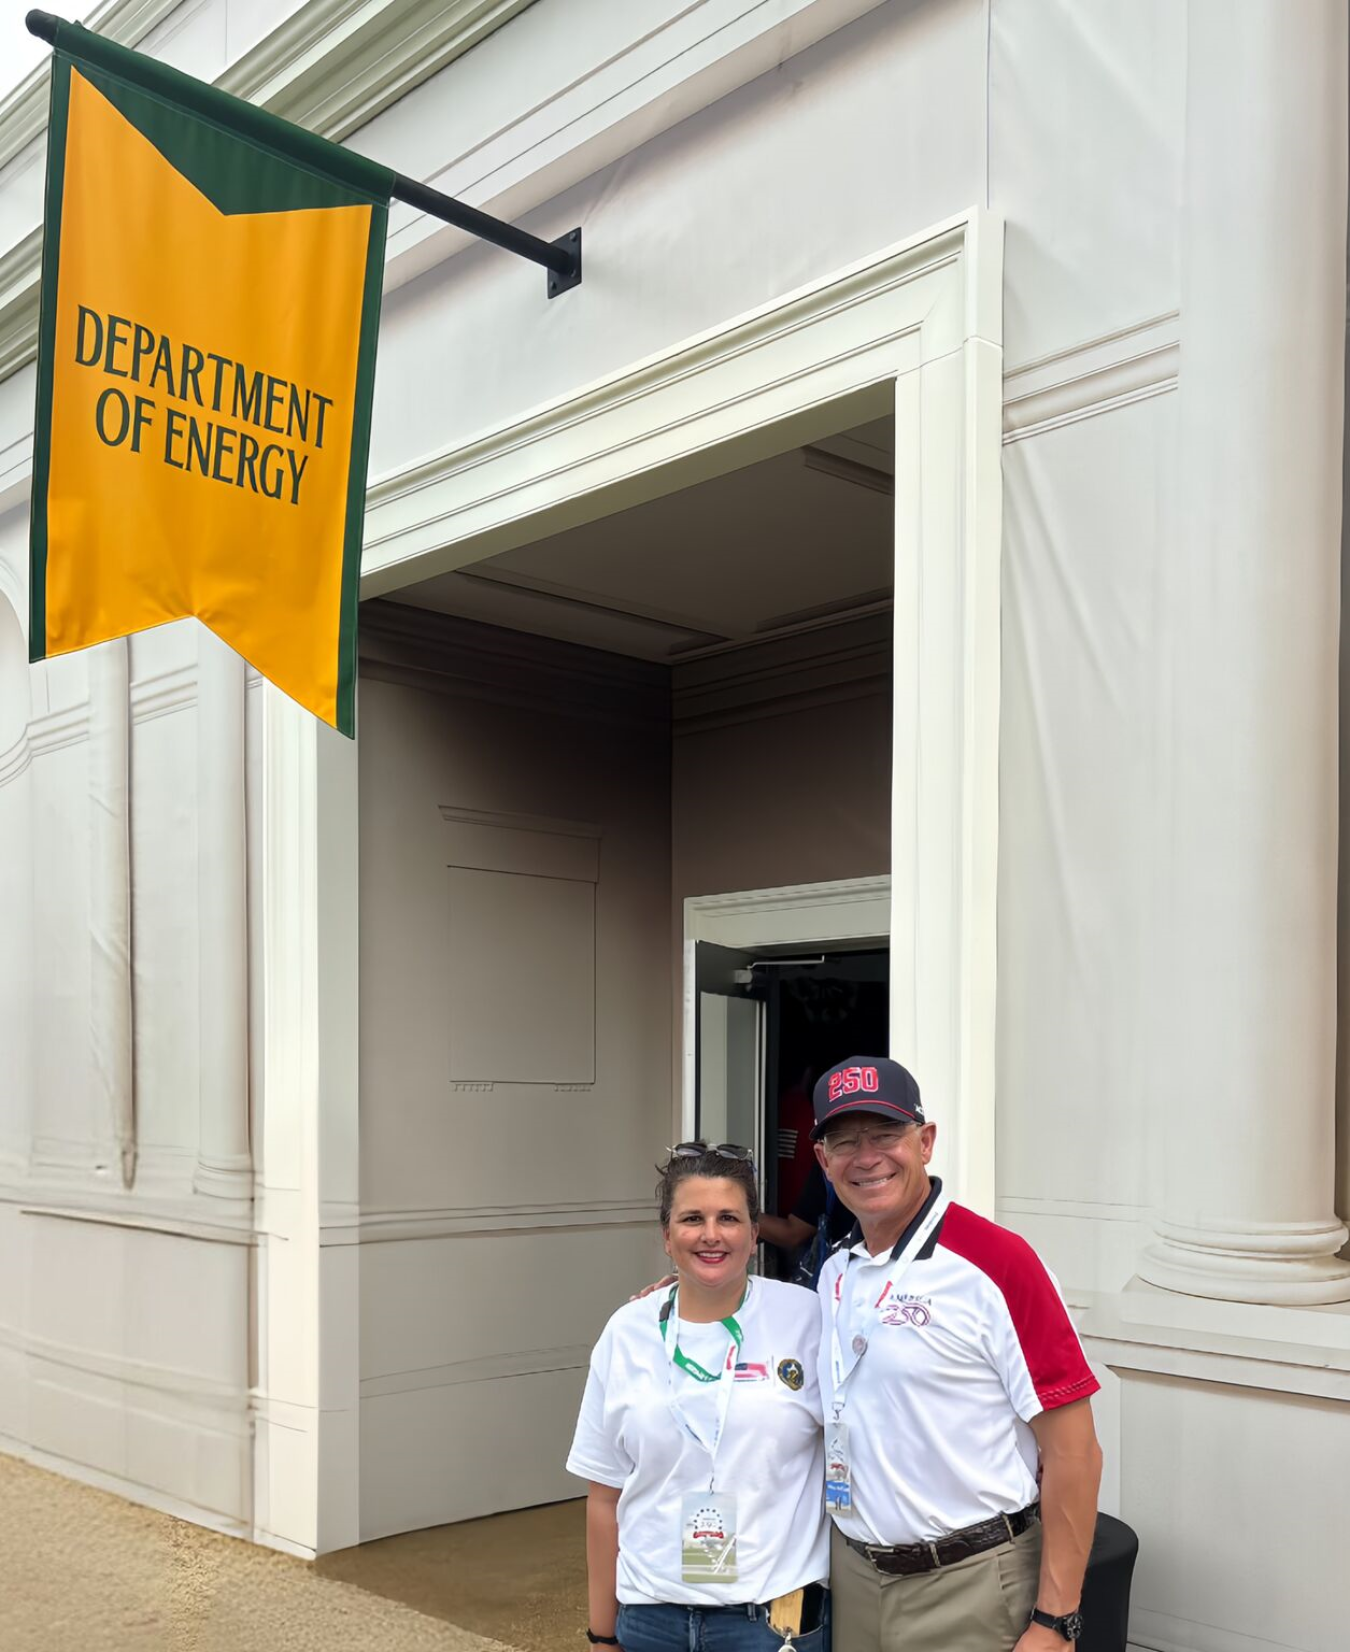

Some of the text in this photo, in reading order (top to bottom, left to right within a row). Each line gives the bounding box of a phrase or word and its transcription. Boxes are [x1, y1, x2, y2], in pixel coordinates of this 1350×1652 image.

[75, 304, 334, 449] DEPARTMENT
[96, 387, 309, 505] OF ENERGY
[828, 1066, 879, 1102] 250
[881, 1303, 931, 1327] 250
